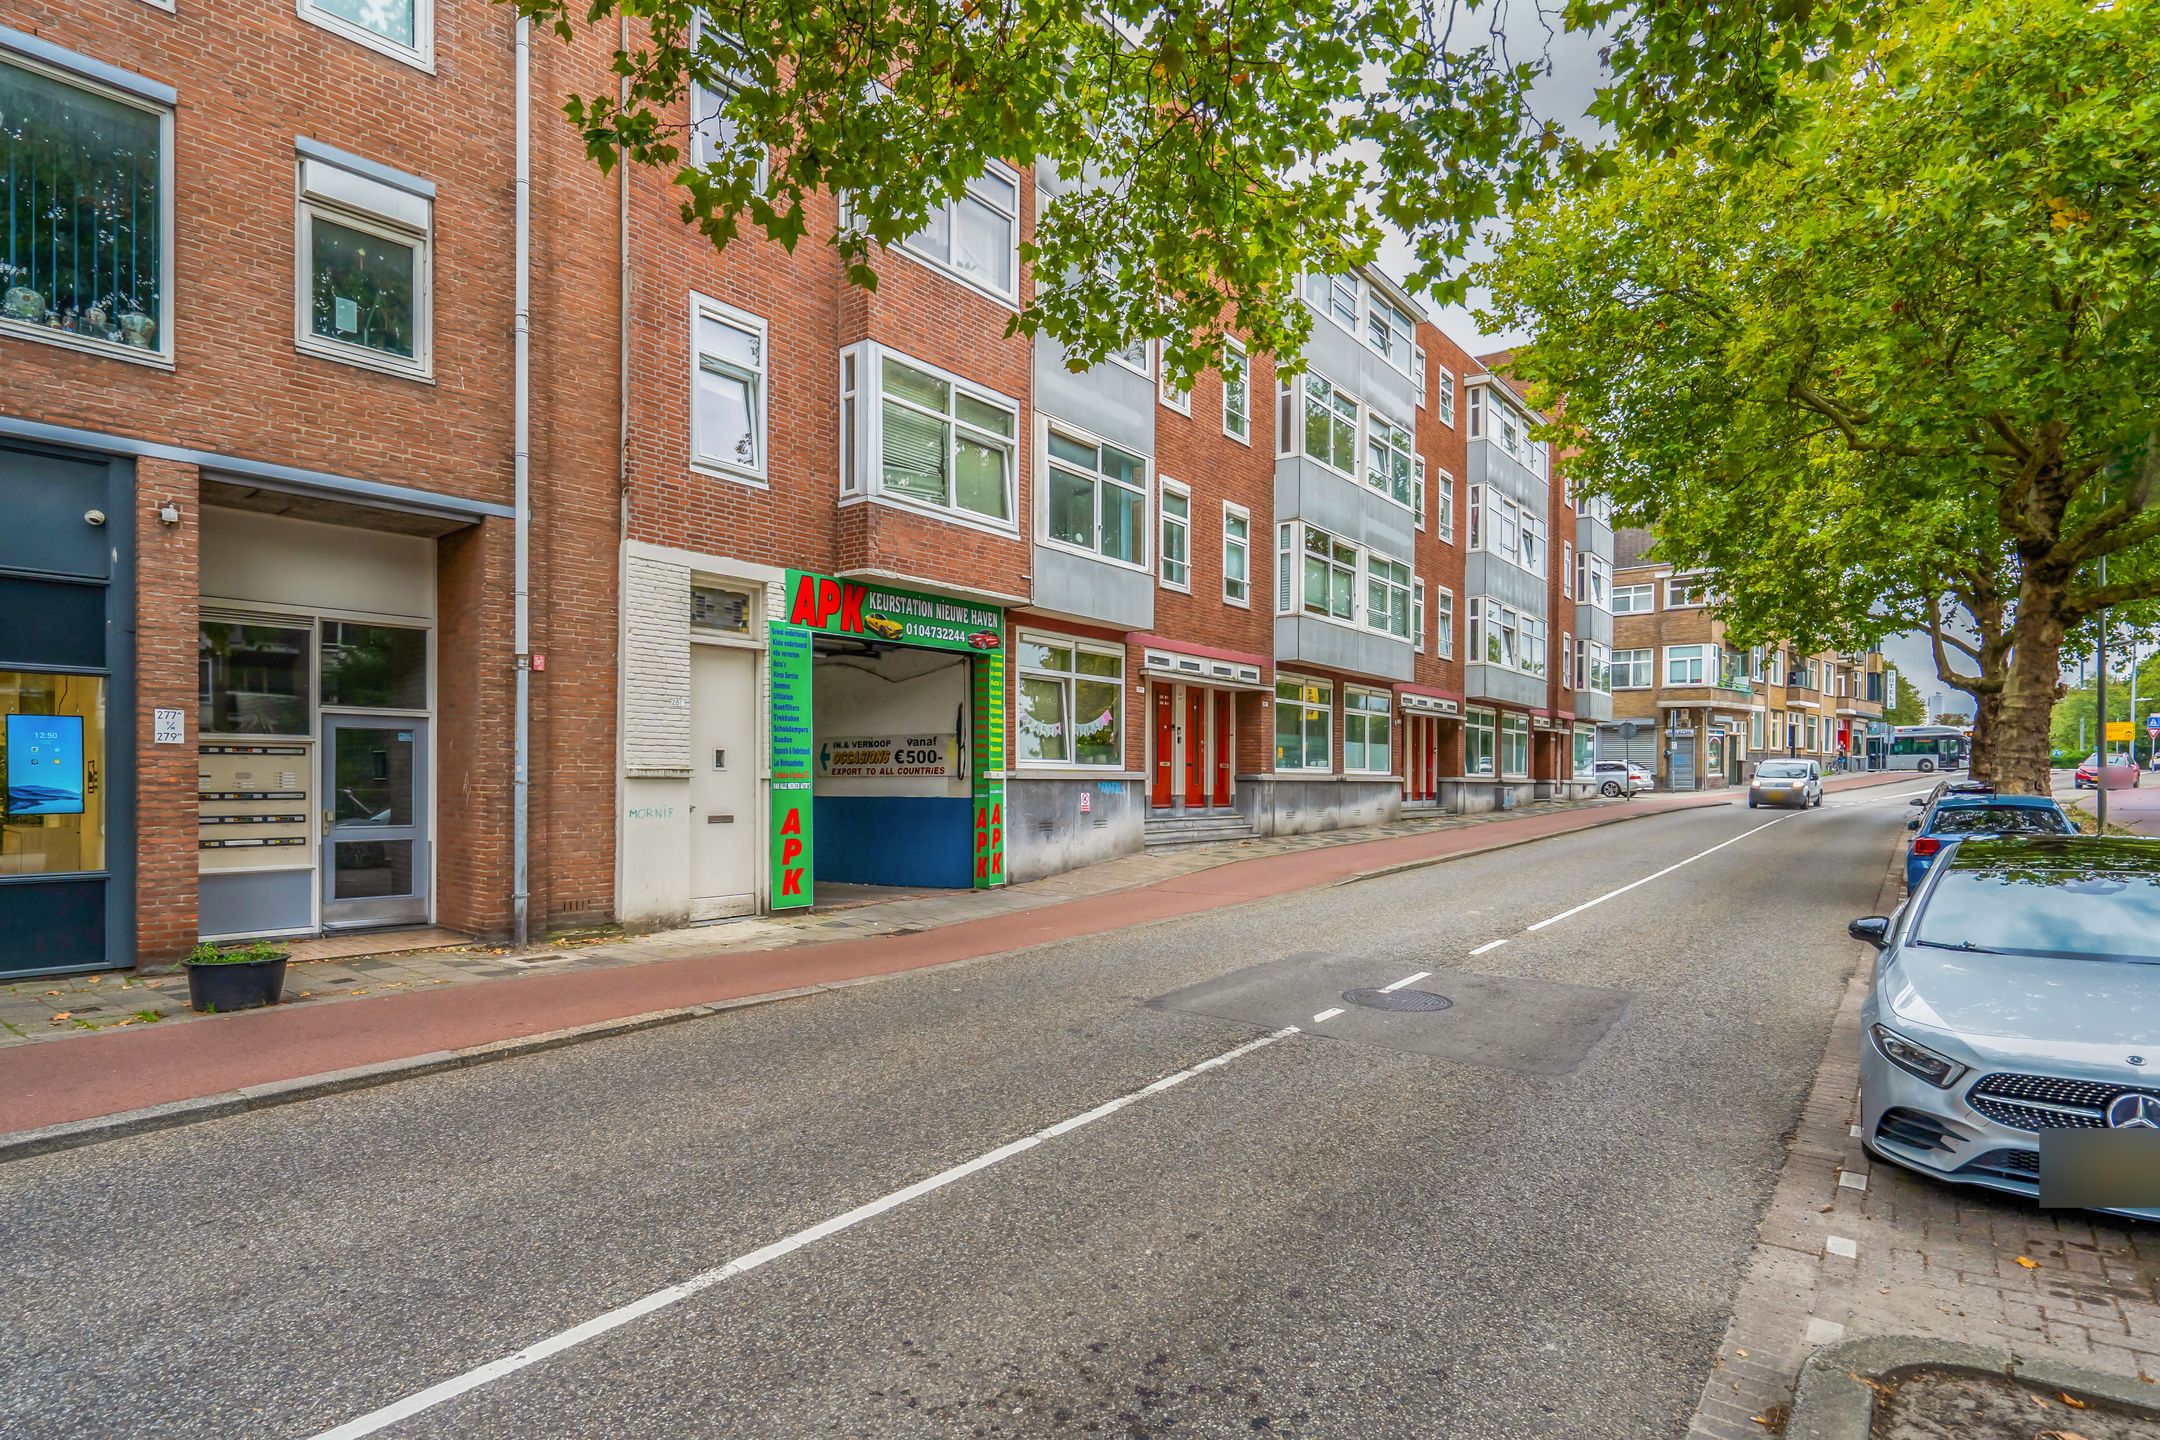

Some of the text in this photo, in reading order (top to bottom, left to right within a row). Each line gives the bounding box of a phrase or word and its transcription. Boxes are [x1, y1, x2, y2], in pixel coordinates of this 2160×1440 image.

[790, 575, 868, 633] APK
[971, 609, 998, 629] HAVEN
[906, 623, 965, 642] 0104732244
[774, 714, 799, 722] Trekhaken
[774, 724, 808, 734] Schokdempers
[774, 735, 792, 743] Banden
[852, 740, 891, 748] VERKOOP
[907, 736, 937, 747] vanaf
[833, 750, 891, 765] OCCASIONS
[831, 767, 945, 775] EXPORT TO ALL COUNTRIES
[975, 807, 988, 878] APK
[991, 803, 1002, 874] APK
[780, 808, 804, 896] APK
